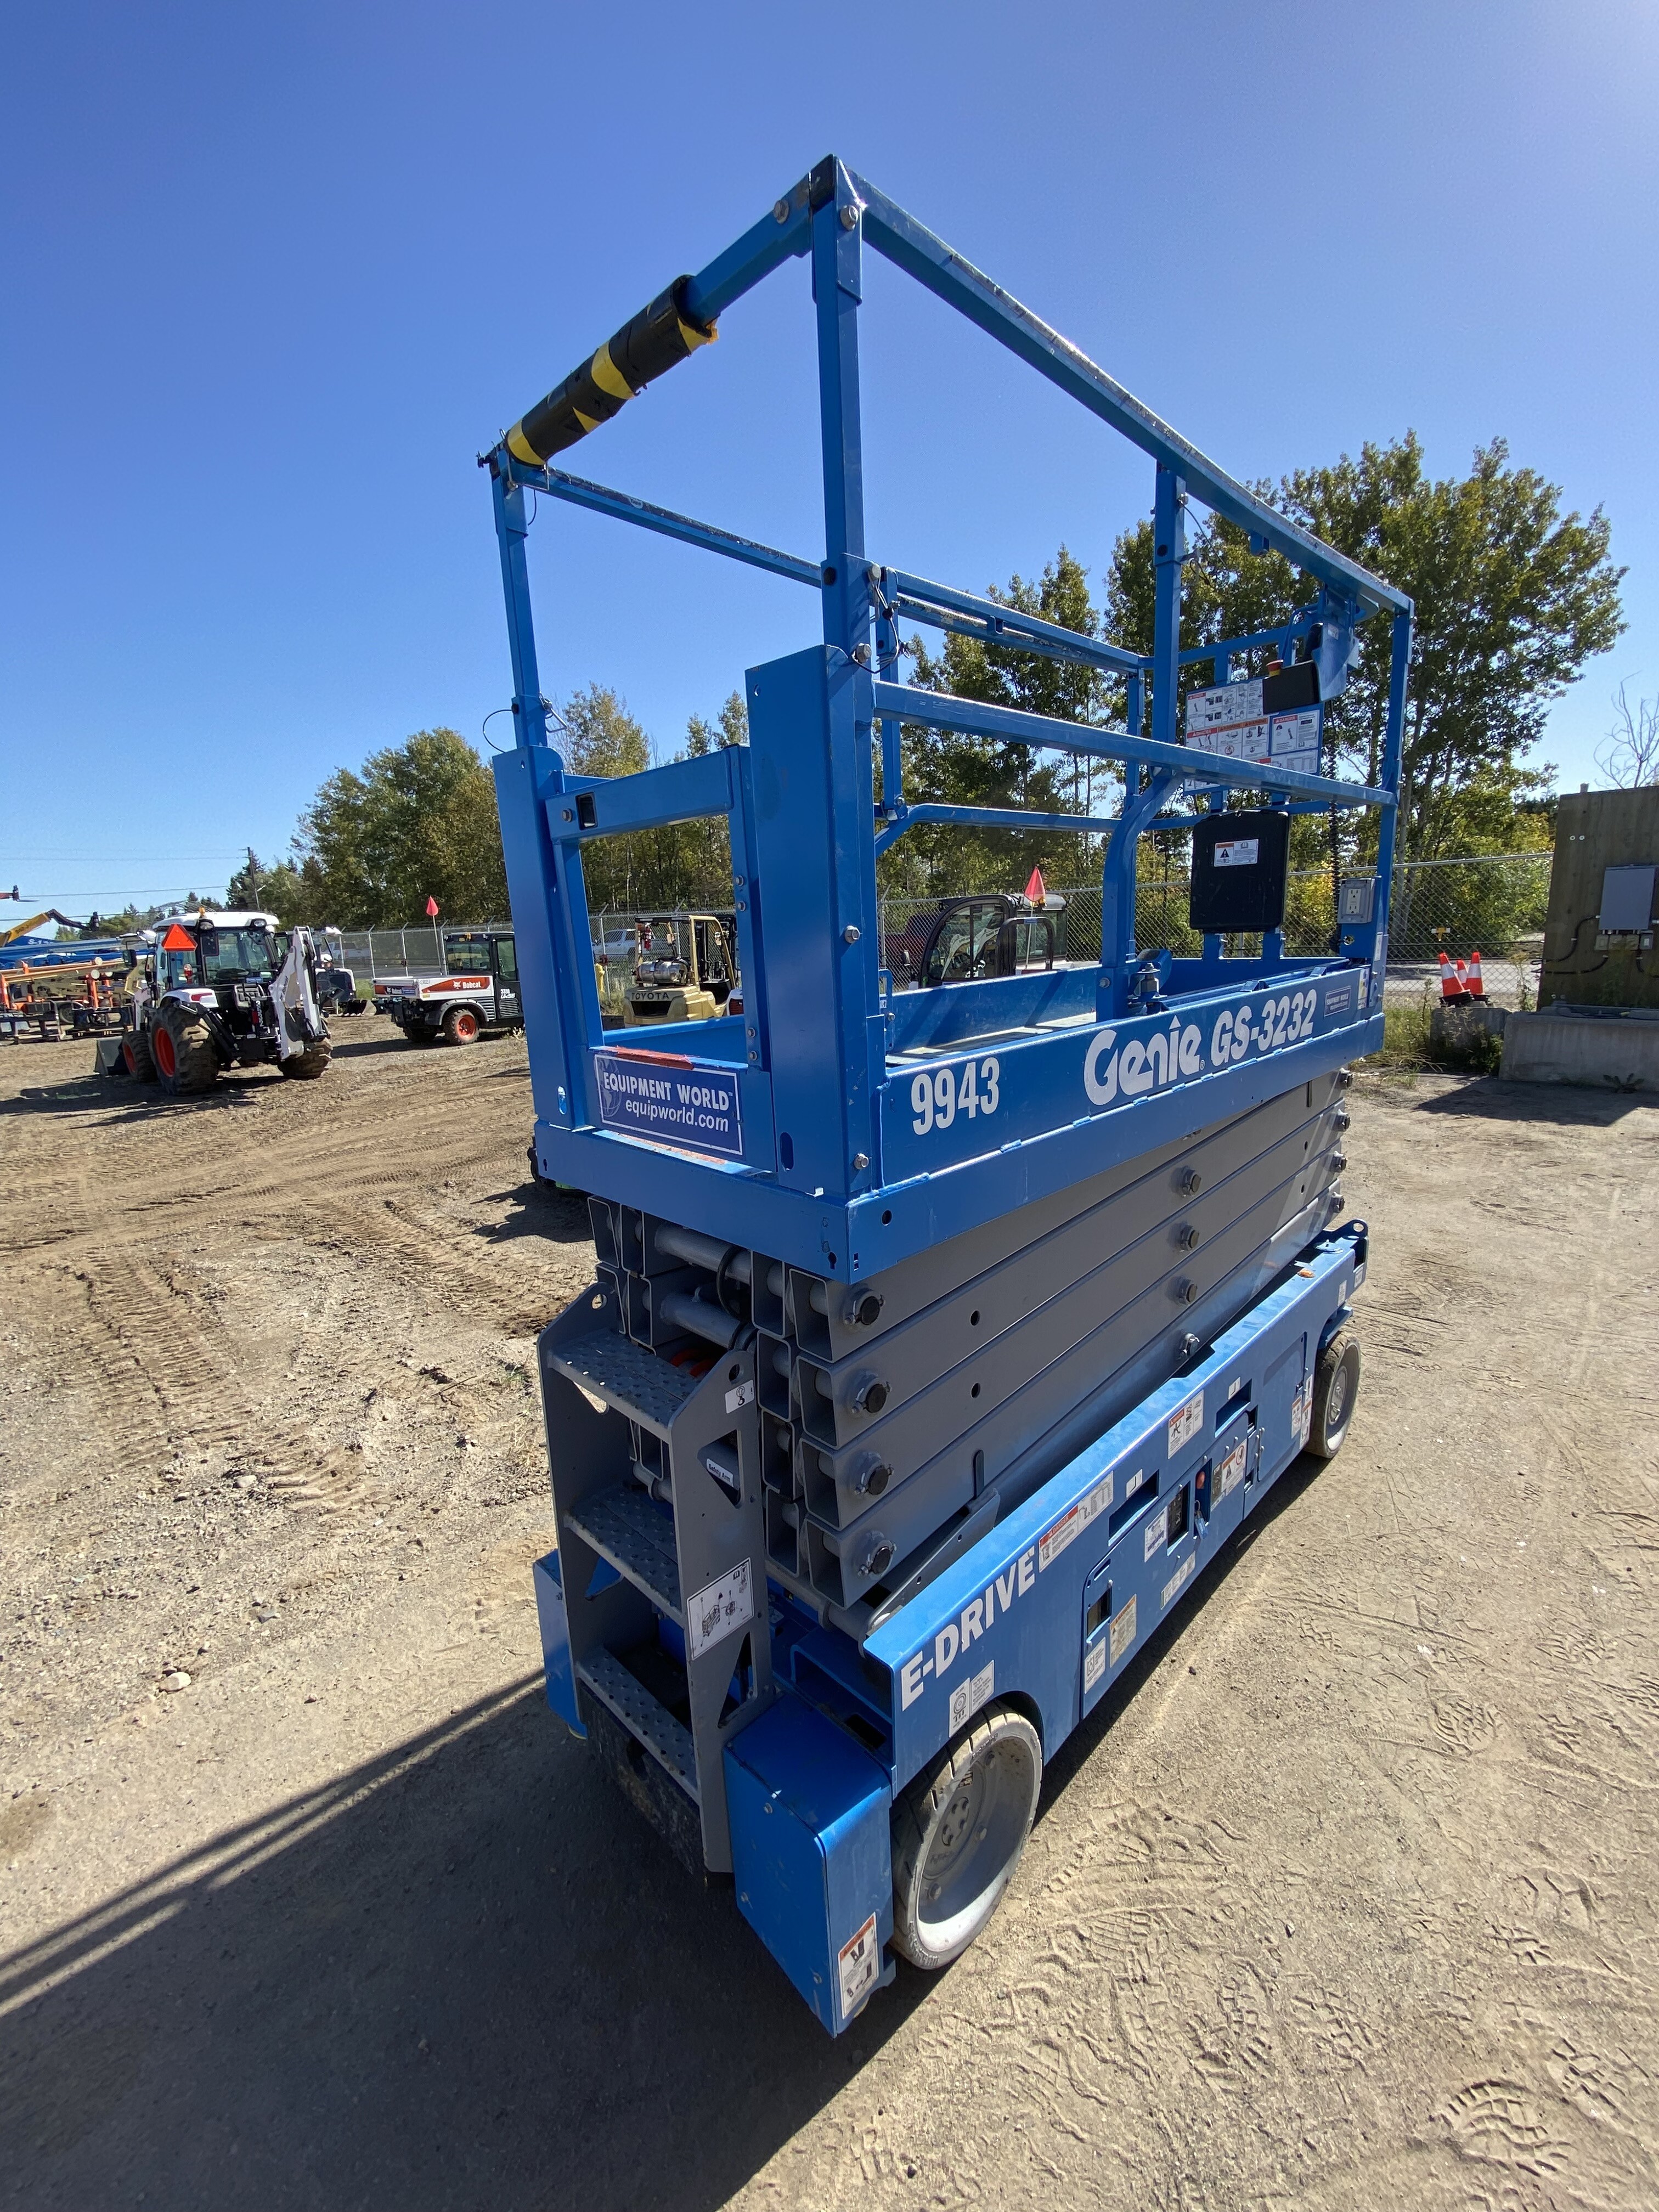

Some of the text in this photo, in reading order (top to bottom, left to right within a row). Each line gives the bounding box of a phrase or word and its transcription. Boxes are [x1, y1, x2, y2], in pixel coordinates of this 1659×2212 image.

[462, 981, 481, 989] Bobcat
[631, 992, 669, 1000] TOYOTA
[1084, 1014, 1202, 1105] Genie
[1210, 988, 1318, 1068] GS-3232
[603, 1072, 730, 1111] EQUIPMENT WORLD
[911, 1057, 1001, 1136] 9943
[625, 1099, 729, 1132] equipworld.com
[708, 1463, 721, 1477] Safety
[901, 1545, 1036, 1712] E-DRIVE
